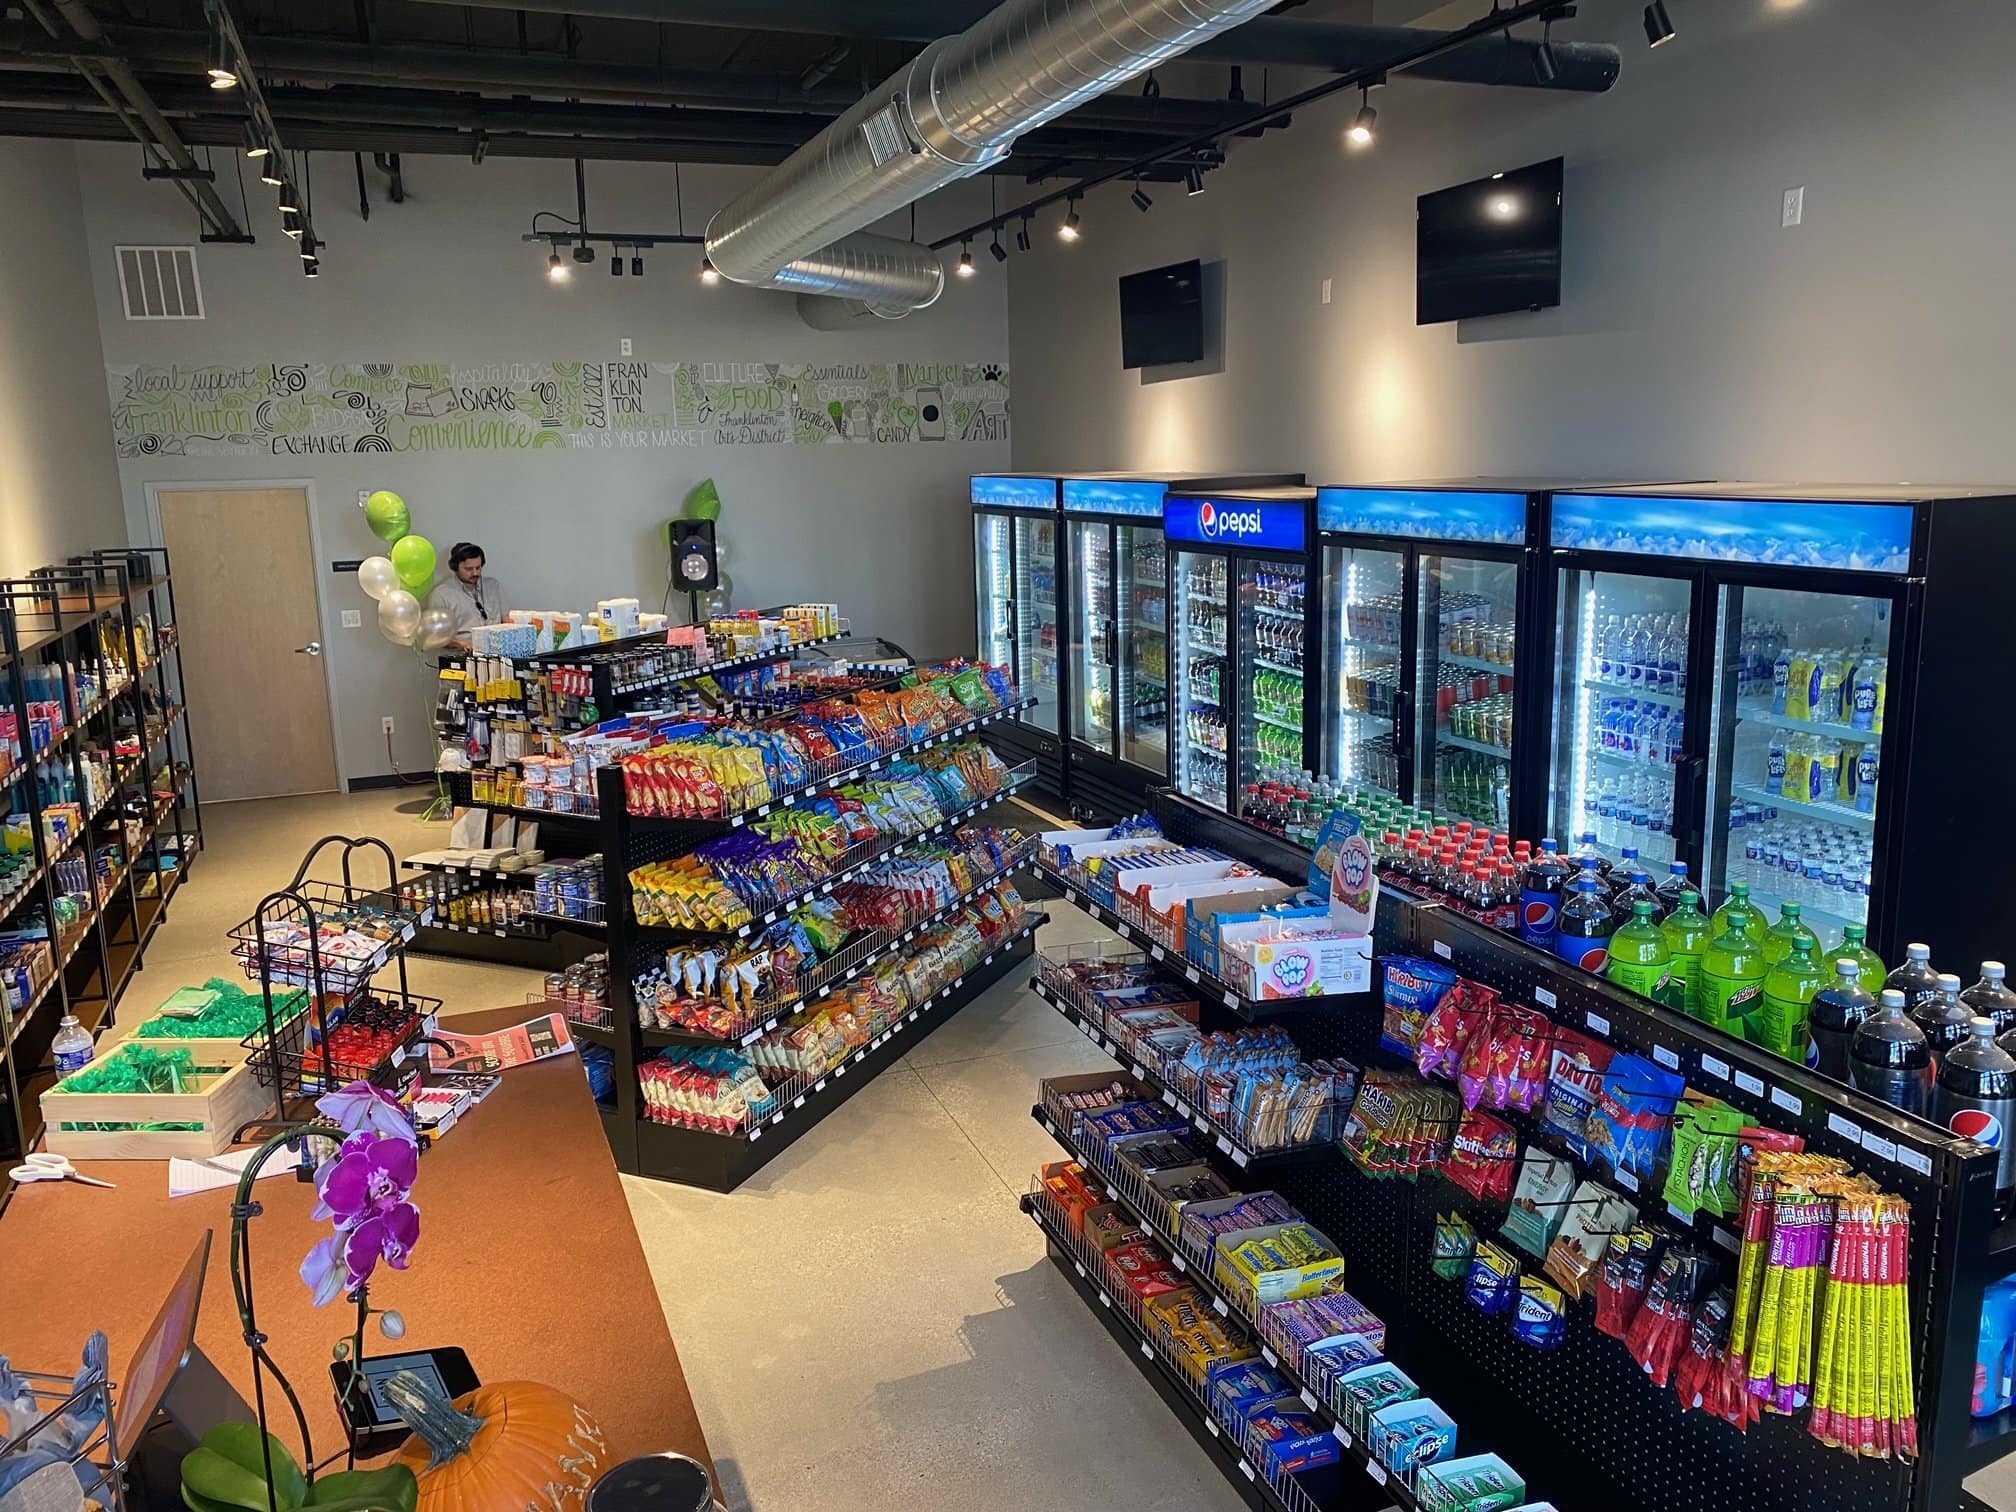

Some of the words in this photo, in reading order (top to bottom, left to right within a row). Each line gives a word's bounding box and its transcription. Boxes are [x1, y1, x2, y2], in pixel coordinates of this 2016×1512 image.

[134, 364, 185, 393] local
[190, 367, 256, 395] support
[582, 363, 603, 398] 2022
[608, 362, 648, 379] FRAN
[703, 362, 765, 383] CULTURE
[802, 364, 870, 382] Essentials
[460, 386, 516, 412] SNACKS
[610, 379, 643, 396] KLIN
[731, 386, 783, 412] FOOD
[127, 402, 255, 433] Franklinton
[612, 414, 668, 430] MARKET
[718, 411, 778, 427] Franklinton
[271, 433, 350, 456] EXCHANGE
[386, 414, 533, 453] Convenience
[568, 432, 594, 449] THIS
[600, 432, 611, 448] IS
[616, 431, 649, 448] YOUR
[651, 429, 708, 448] MARKET
[876, 426, 911, 443] CANDY
[1218, 507, 1262, 539] pepsi
[1855, 688, 1876, 701] PURE
[1857, 699, 1875, 709] LIFE
[1342, 848, 1369, 871] BLOW
[1345, 867, 1365, 889] POP
[750, 954, 764, 969] RAP
[1273, 954, 1311, 978] BLOW
[1281, 968, 1308, 988] POP
[1556, 1056, 1603, 1095] DAVID
[1361, 1084, 1398, 1118] HARIBO
[1551, 1086, 1588, 1113] ORIGINAL
[1862, 1240, 1870, 1279] ORIGINAL
[1879, 1241, 1889, 1280] ORIGINAL
[1301, 1266, 1342, 1283] Butterfinger
[1405, 1434, 1450, 1465] eclipse
